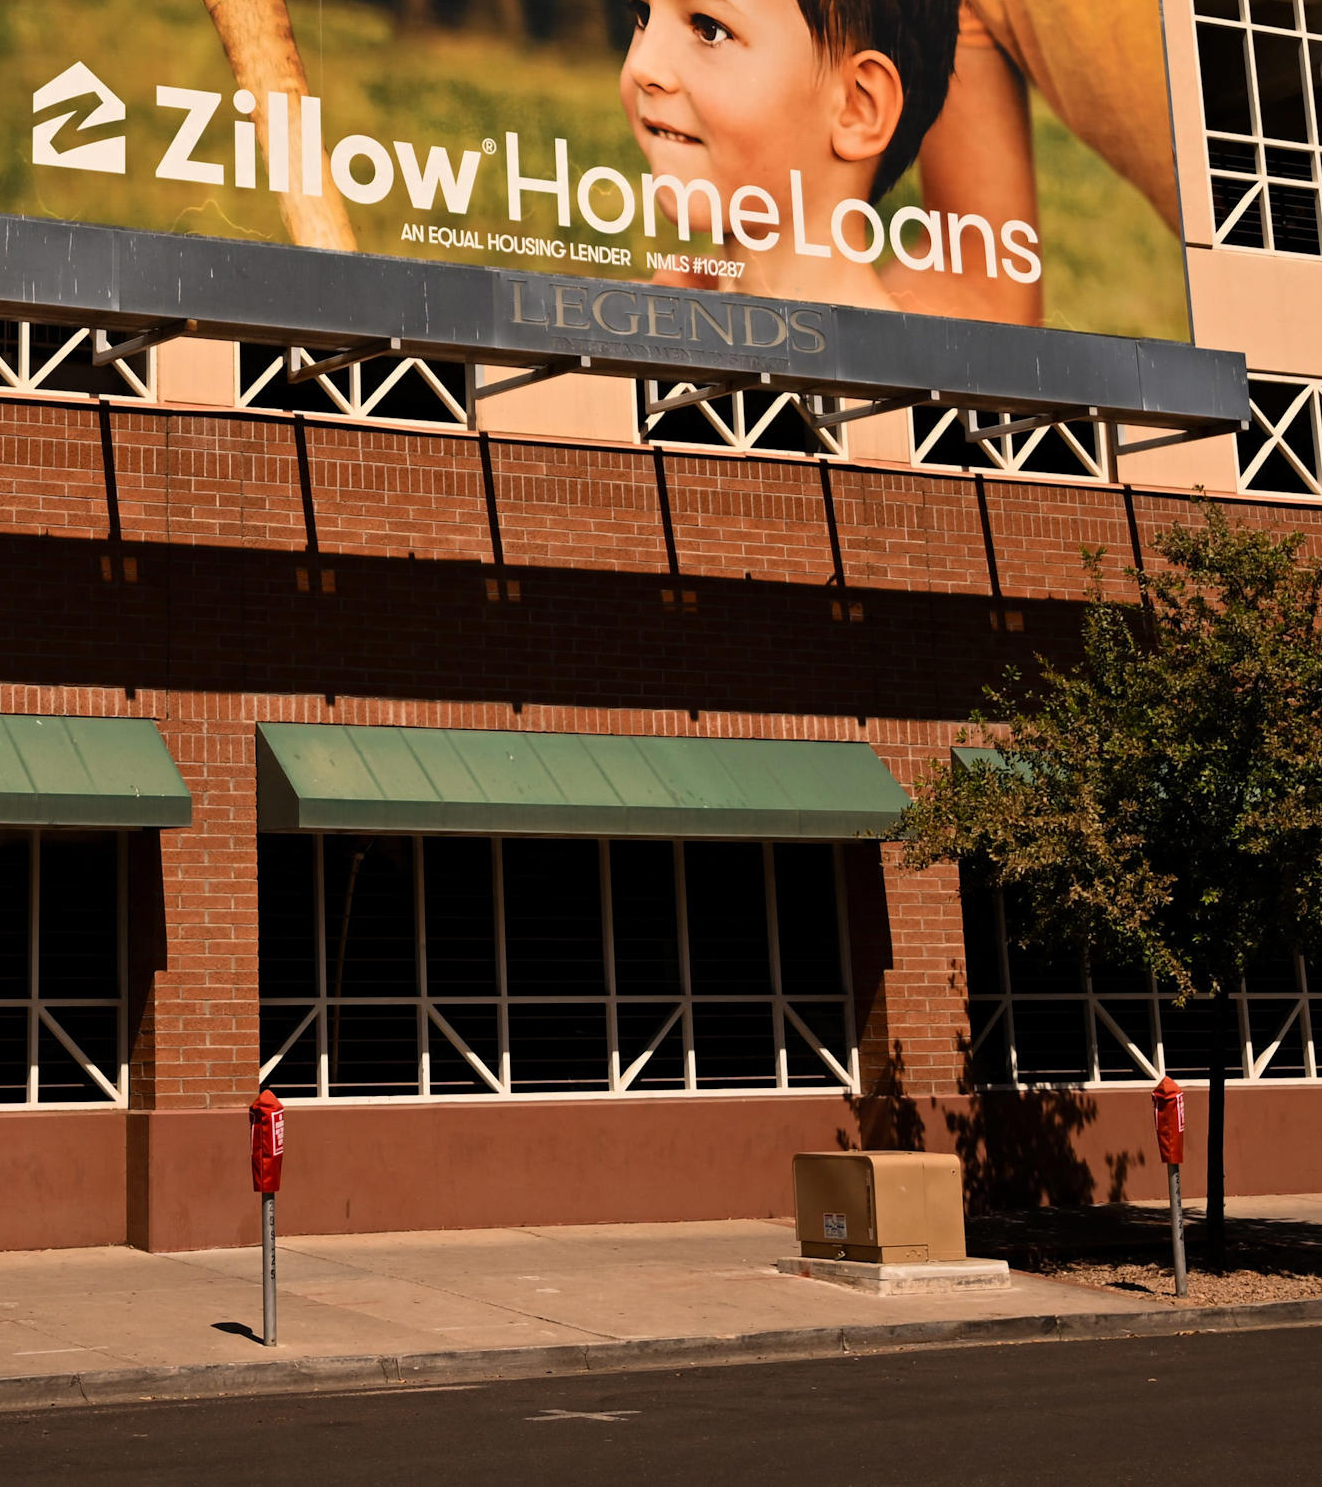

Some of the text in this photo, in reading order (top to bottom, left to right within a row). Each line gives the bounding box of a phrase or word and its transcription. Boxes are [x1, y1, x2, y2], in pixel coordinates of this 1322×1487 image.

[401, 223, 746, 279] AN EQUAL HOUSING LENDER NMLS #10287
[506, 278, 827, 355] LEGENDS
